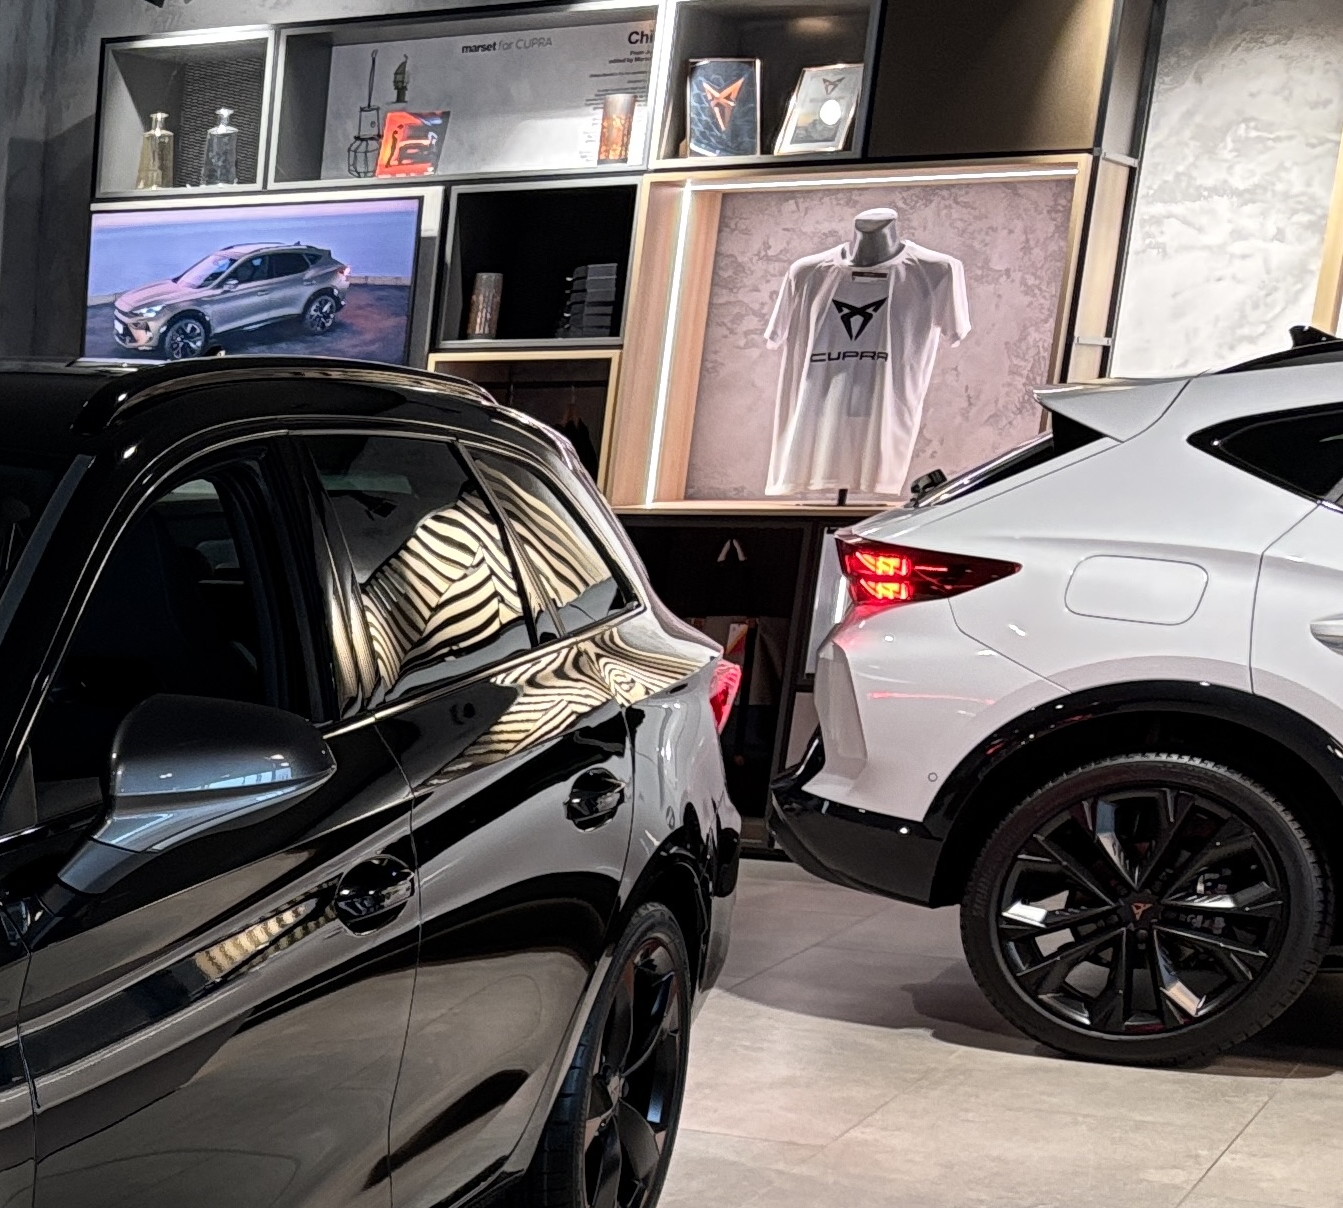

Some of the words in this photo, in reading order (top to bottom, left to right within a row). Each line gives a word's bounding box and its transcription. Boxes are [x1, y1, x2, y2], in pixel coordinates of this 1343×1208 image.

[461, 42, 497, 54] marset
[498, 40, 514, 51] for
[515, 37, 553, 50] CUPRA
[809, 351, 889, 363] CUPRA
